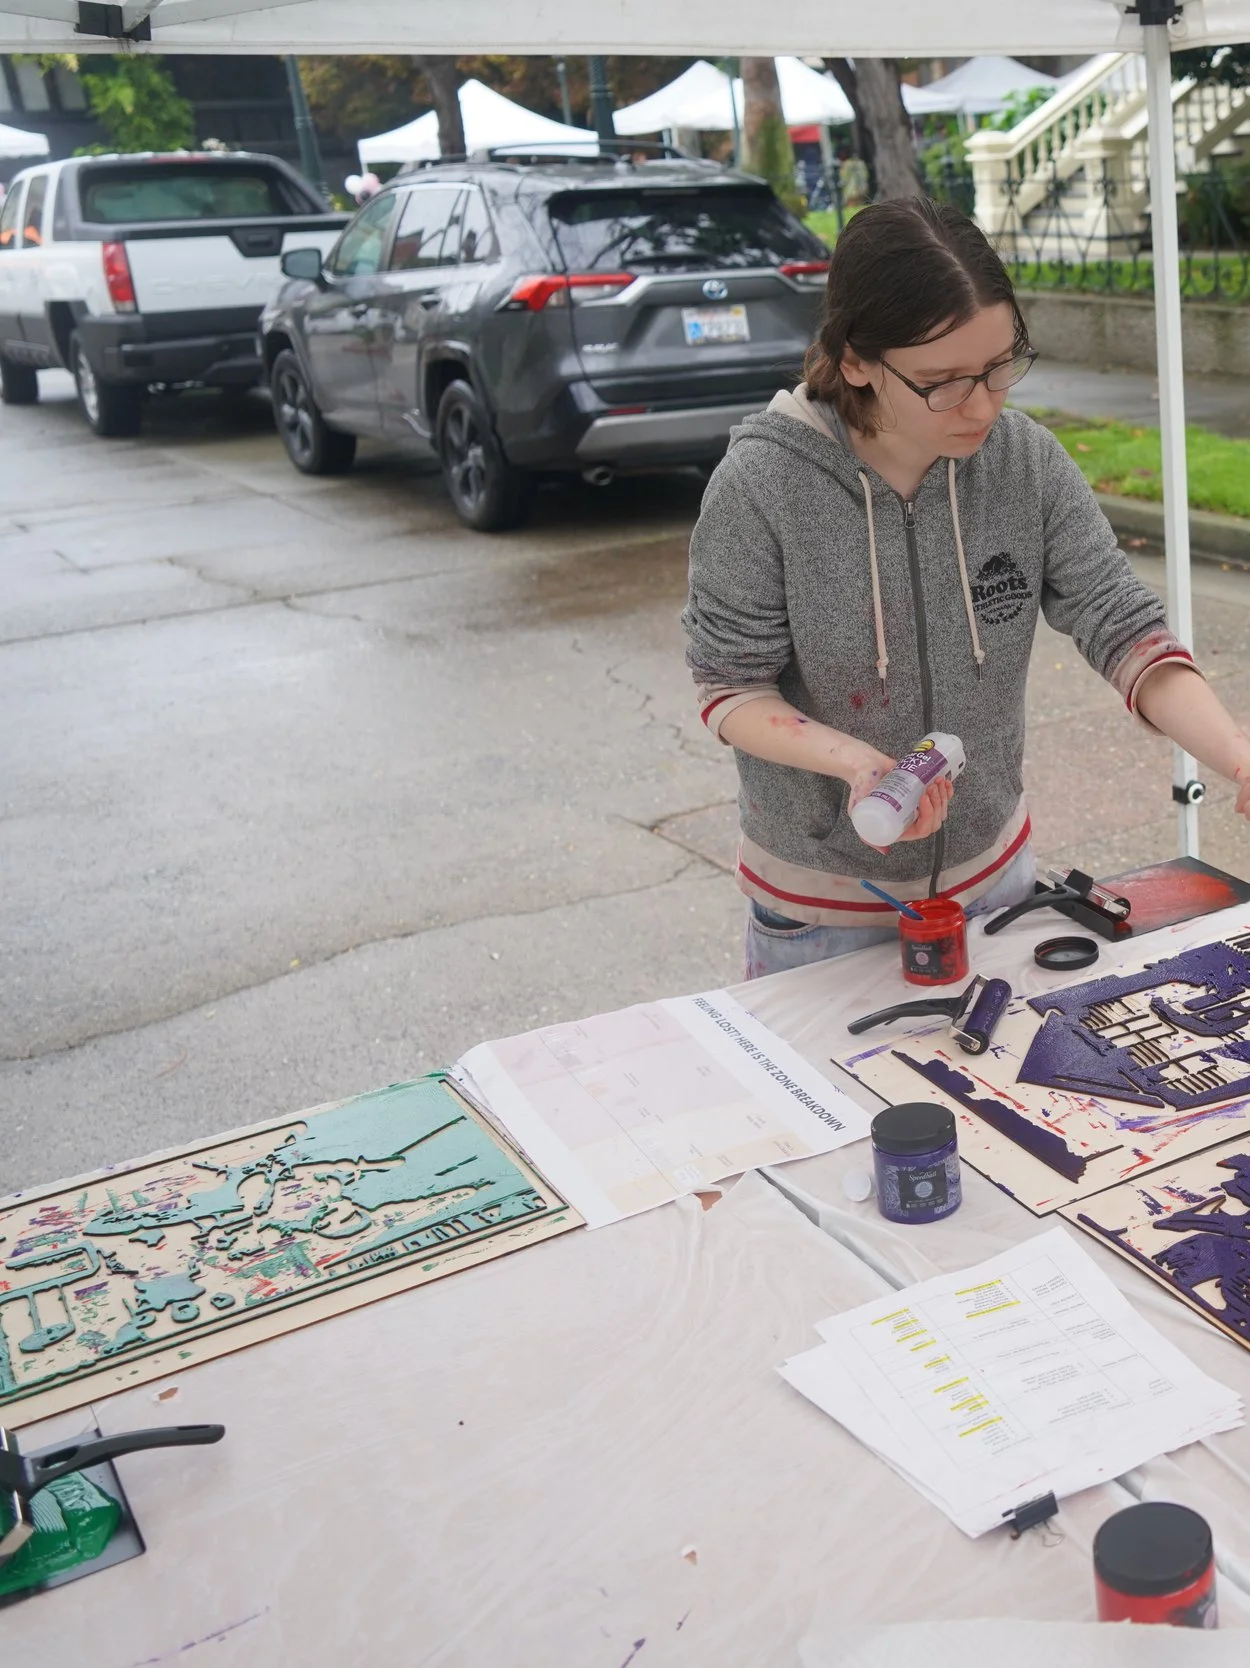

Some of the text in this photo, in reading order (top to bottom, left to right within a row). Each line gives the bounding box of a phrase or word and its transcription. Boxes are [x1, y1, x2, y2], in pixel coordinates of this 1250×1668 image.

[970, 576, 1028, 603] Roots
[973, 591, 1033, 612] THLETIC GOODS
[916, 752, 932, 761] Gel
[896, 763, 918, 772] LUE
[692, 998, 847, 1132] FEELING LOST? HERE IS THE ZONE BREAKDOWN
